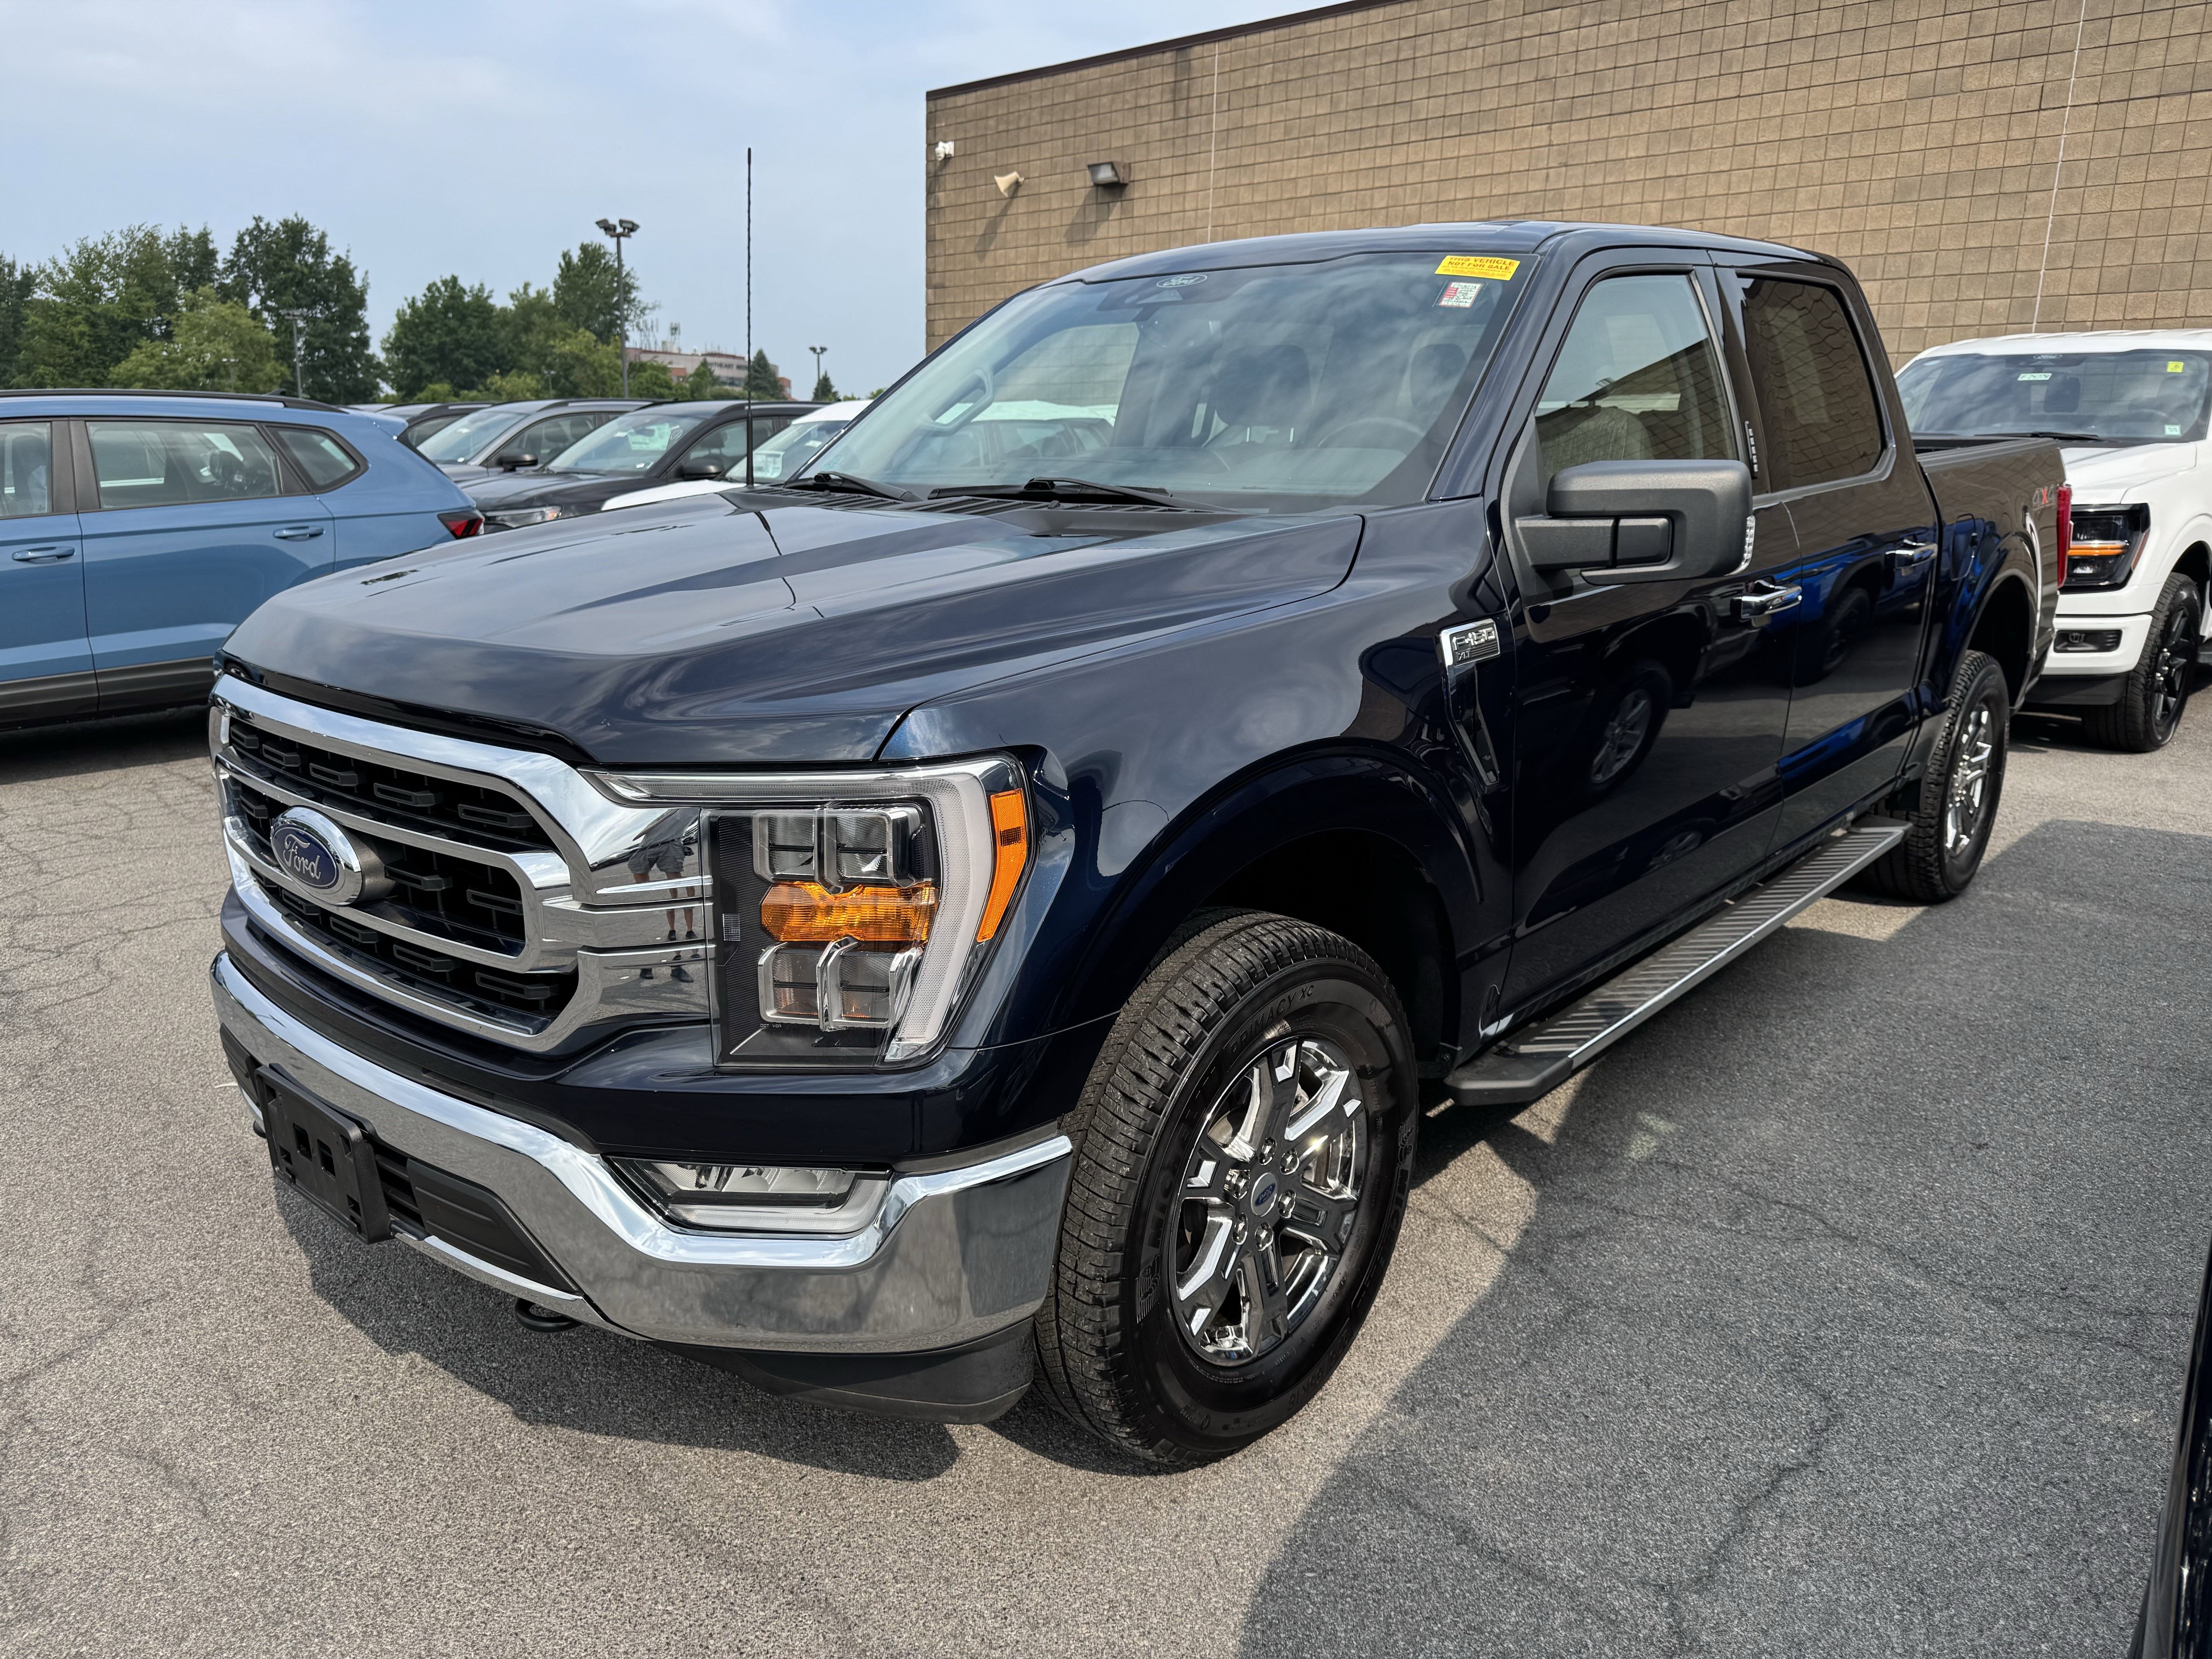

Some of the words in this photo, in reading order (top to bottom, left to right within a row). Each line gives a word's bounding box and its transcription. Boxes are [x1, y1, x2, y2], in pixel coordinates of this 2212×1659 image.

[1474, 258, 1515, 267] VEHICLE
[1163, 276, 1200, 286] Ford
[283, 833, 321, 880] Ford
[1230, 991, 1297, 1053] PRIMACY
[1299, 985, 1314, 1000] XC
[1259, 1186, 1273, 1204] Ford
